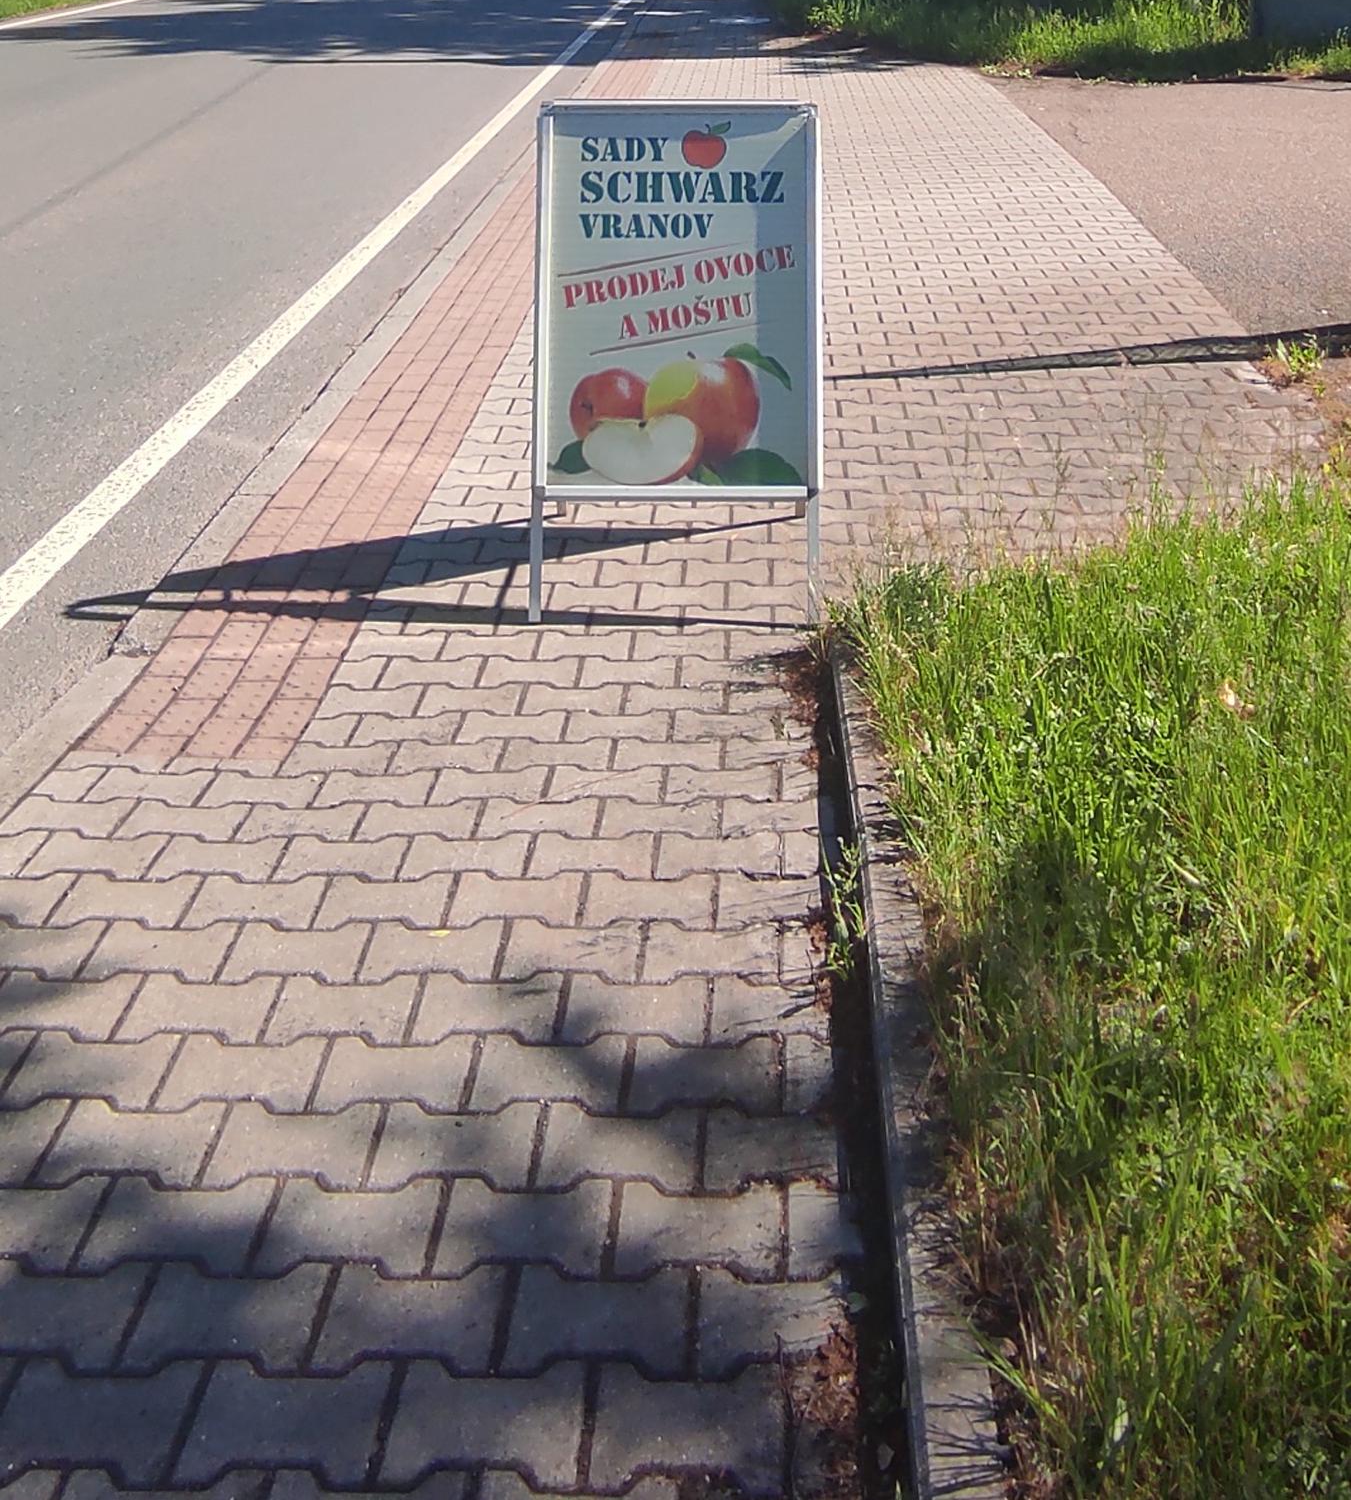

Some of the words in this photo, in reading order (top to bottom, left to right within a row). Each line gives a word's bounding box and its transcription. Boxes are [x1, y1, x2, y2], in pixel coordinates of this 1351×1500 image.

[580, 136, 669, 163] SADY
[580, 170, 785, 204] SCHWARZ
[578, 213, 714, 239] VRANOV
[563, 264, 686, 309] PRODEJ
[694, 244, 796, 285] OVOCE
[619, 314, 639, 340] A
[646, 292, 754, 336] MOŠTU
